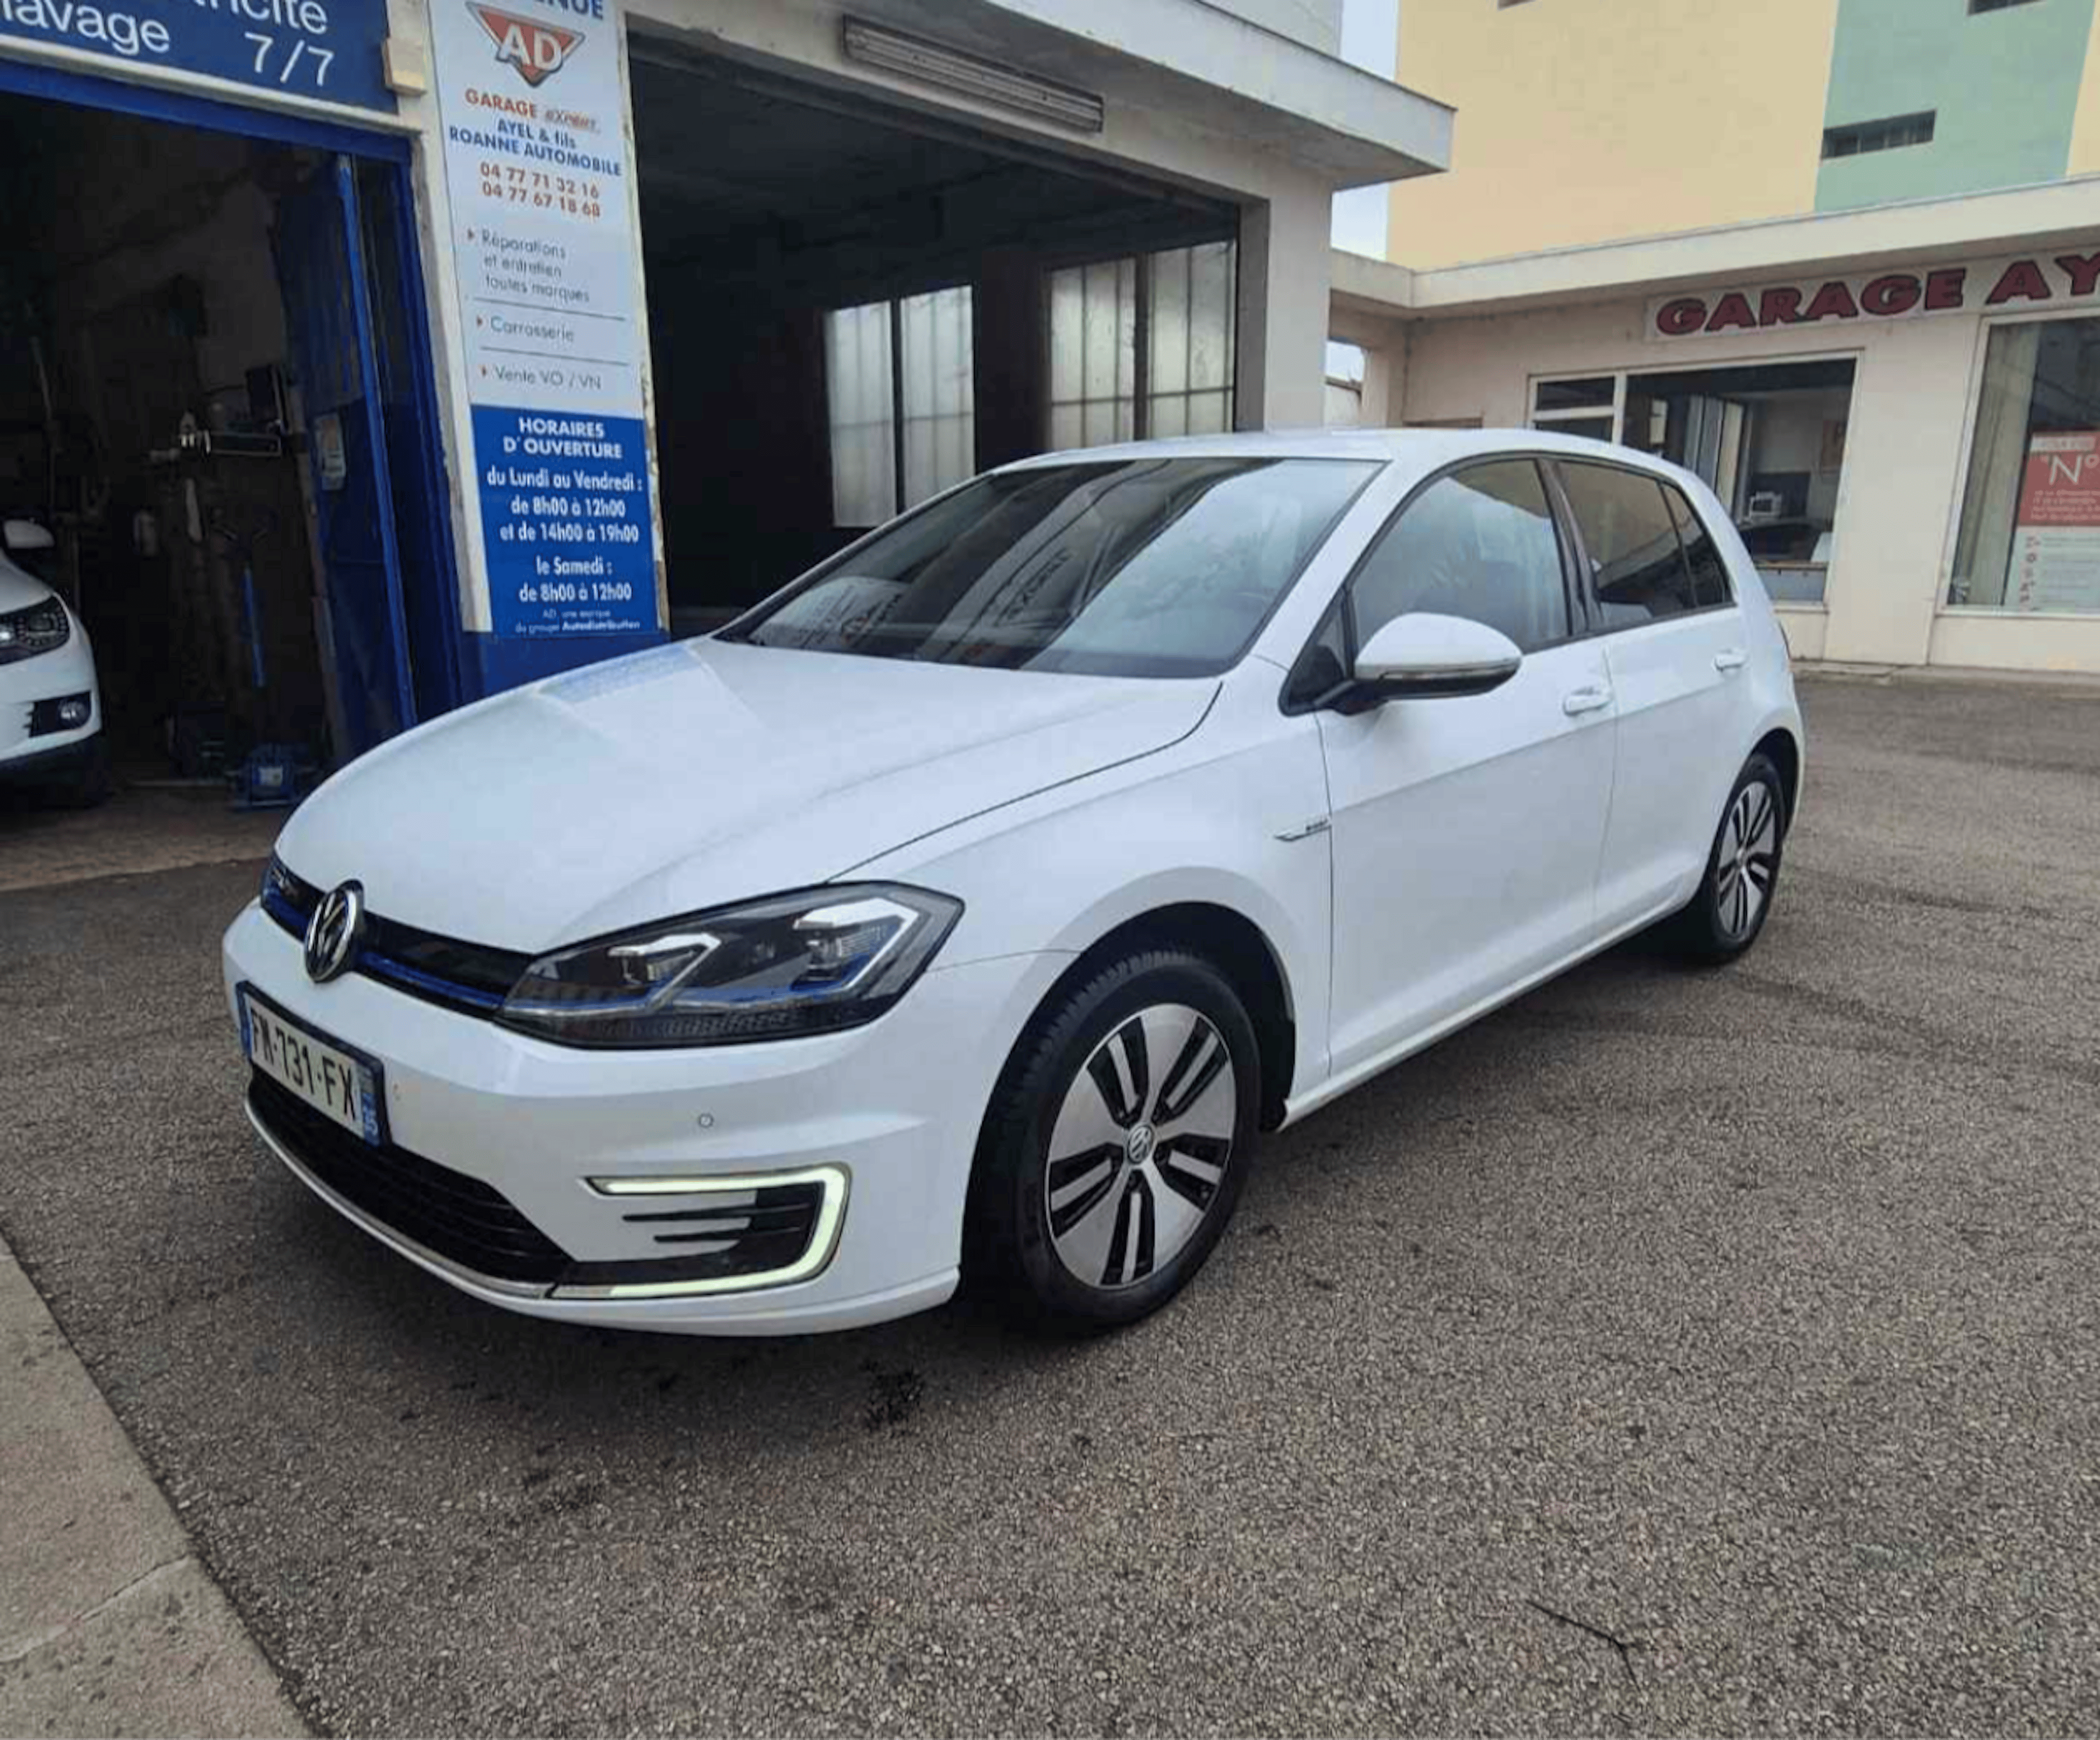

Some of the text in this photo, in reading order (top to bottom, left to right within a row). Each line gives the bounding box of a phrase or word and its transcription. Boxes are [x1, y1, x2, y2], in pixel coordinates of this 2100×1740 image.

[244, 31, 334, 86] 7/7
[498, 24, 562, 71] AD
[465, 88, 537, 119] GARAGE
[498, 118, 534, 140] AYEL
[539, 128, 549, 143] &
[449, 125, 622, 177] ROANNE AUTOMOBILE
[480, 162, 600, 200] 04 77 71 32 16
[482, 181, 503, 199] 04
[509, 186, 528, 203] 77
[533, 191, 553, 208] 67
[559, 196, 578, 213] 18
[482, 228, 567, 260] Réparations
[484, 254, 562, 278] et entretien
[485, 272, 590, 305] toutes marques
[1655, 251, 2100, 336] GARAGE AY
[491, 314, 574, 344] Carrosserie
[495, 364, 536, 385] Vente
[539, 369, 564, 387] VO
[578, 374, 602, 391] VN
[518, 416, 606, 439] HORAIRES
[486, 463, 506, 487] du
[508, 466, 550, 489] Lundi
[552, 472, 572, 490] au
[573, 468, 634, 492] Vendredi
[510, 493, 627, 519] de 8h00 à 12h00
[499, 519, 640, 544] et de 14h00 à 19h00
[535, 554, 551, 576] le
[552, 554, 604, 577] Samedi
[518, 581, 633, 603] de 8h00 à 12h00
